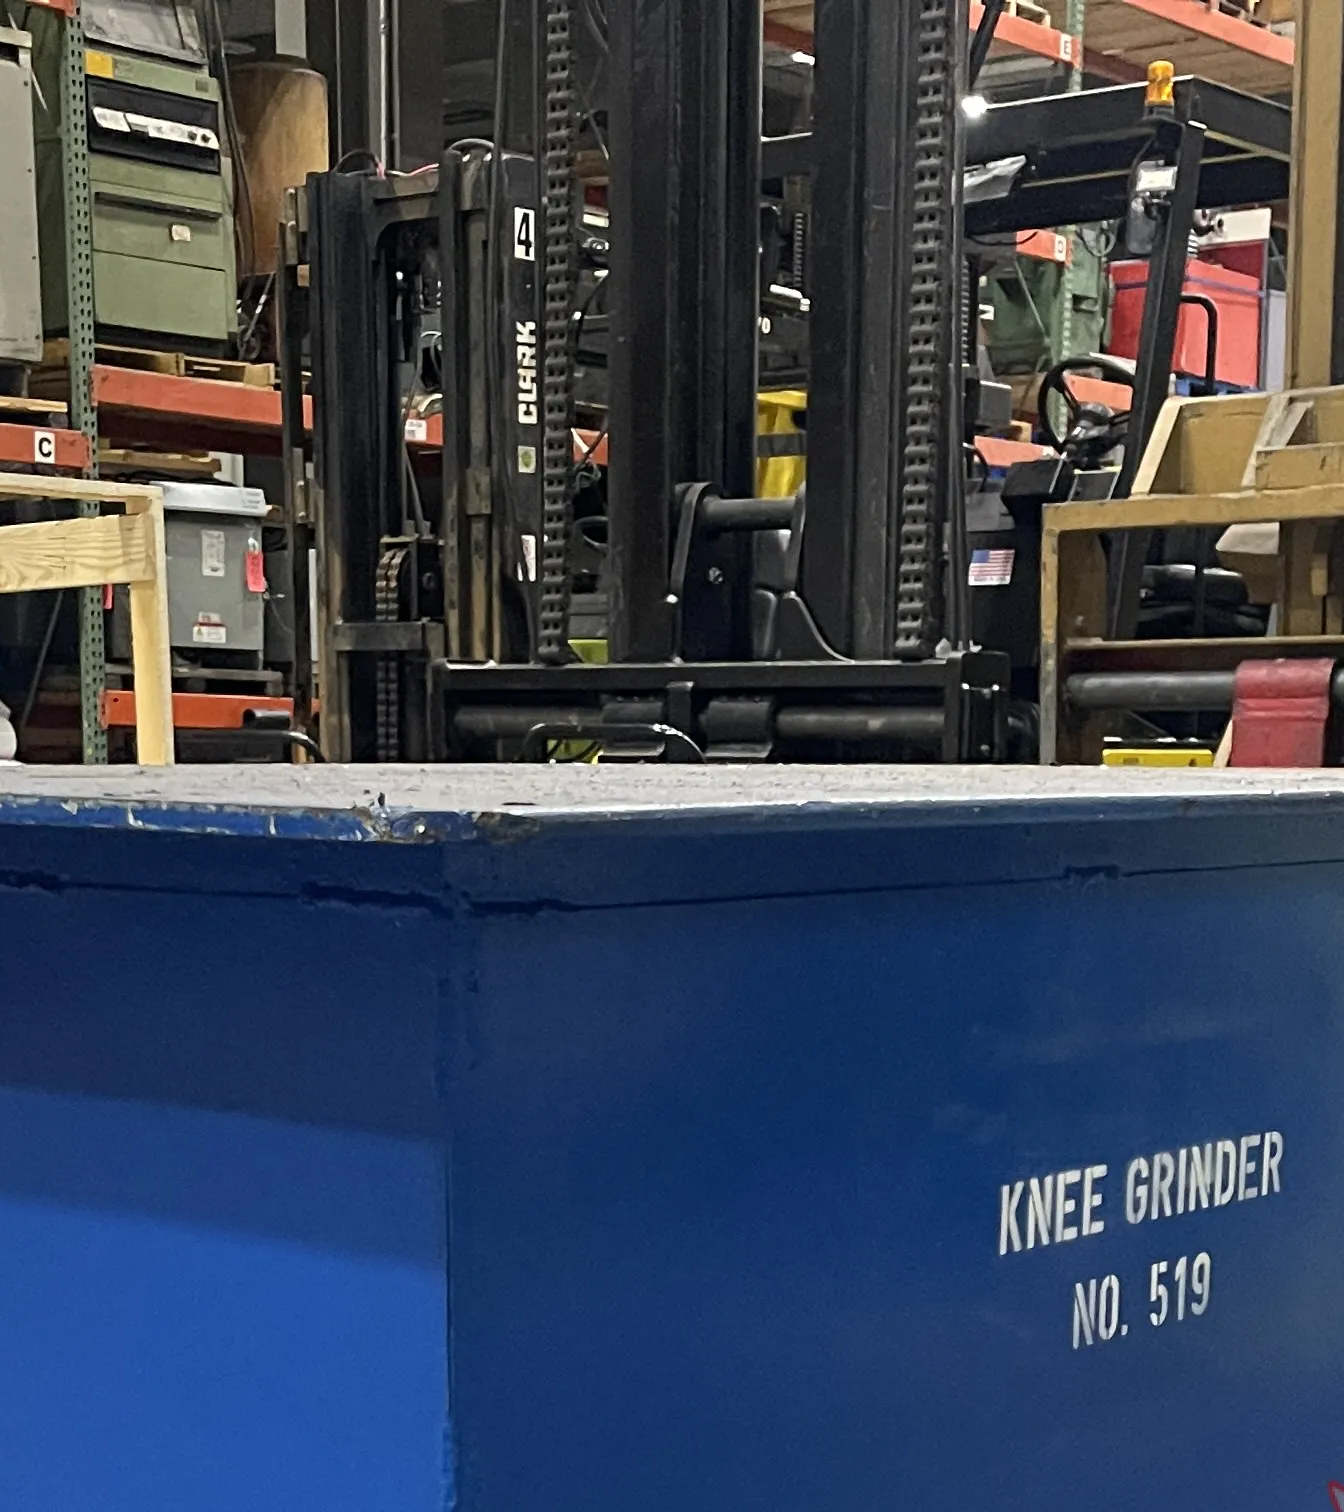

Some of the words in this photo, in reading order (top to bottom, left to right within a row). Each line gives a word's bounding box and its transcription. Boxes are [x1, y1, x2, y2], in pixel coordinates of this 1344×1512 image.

[517, 212, 533, 257] 4
[516, 321, 538, 425] CLARK
[39, 437, 52, 458] C
[998, 1163, 1108, 1256] KNEE
[1125, 1130, 1285, 1225] GRINDER
[1072, 1273, 1129, 1350] NO.
[1148, 1251, 1212, 1327] 519
